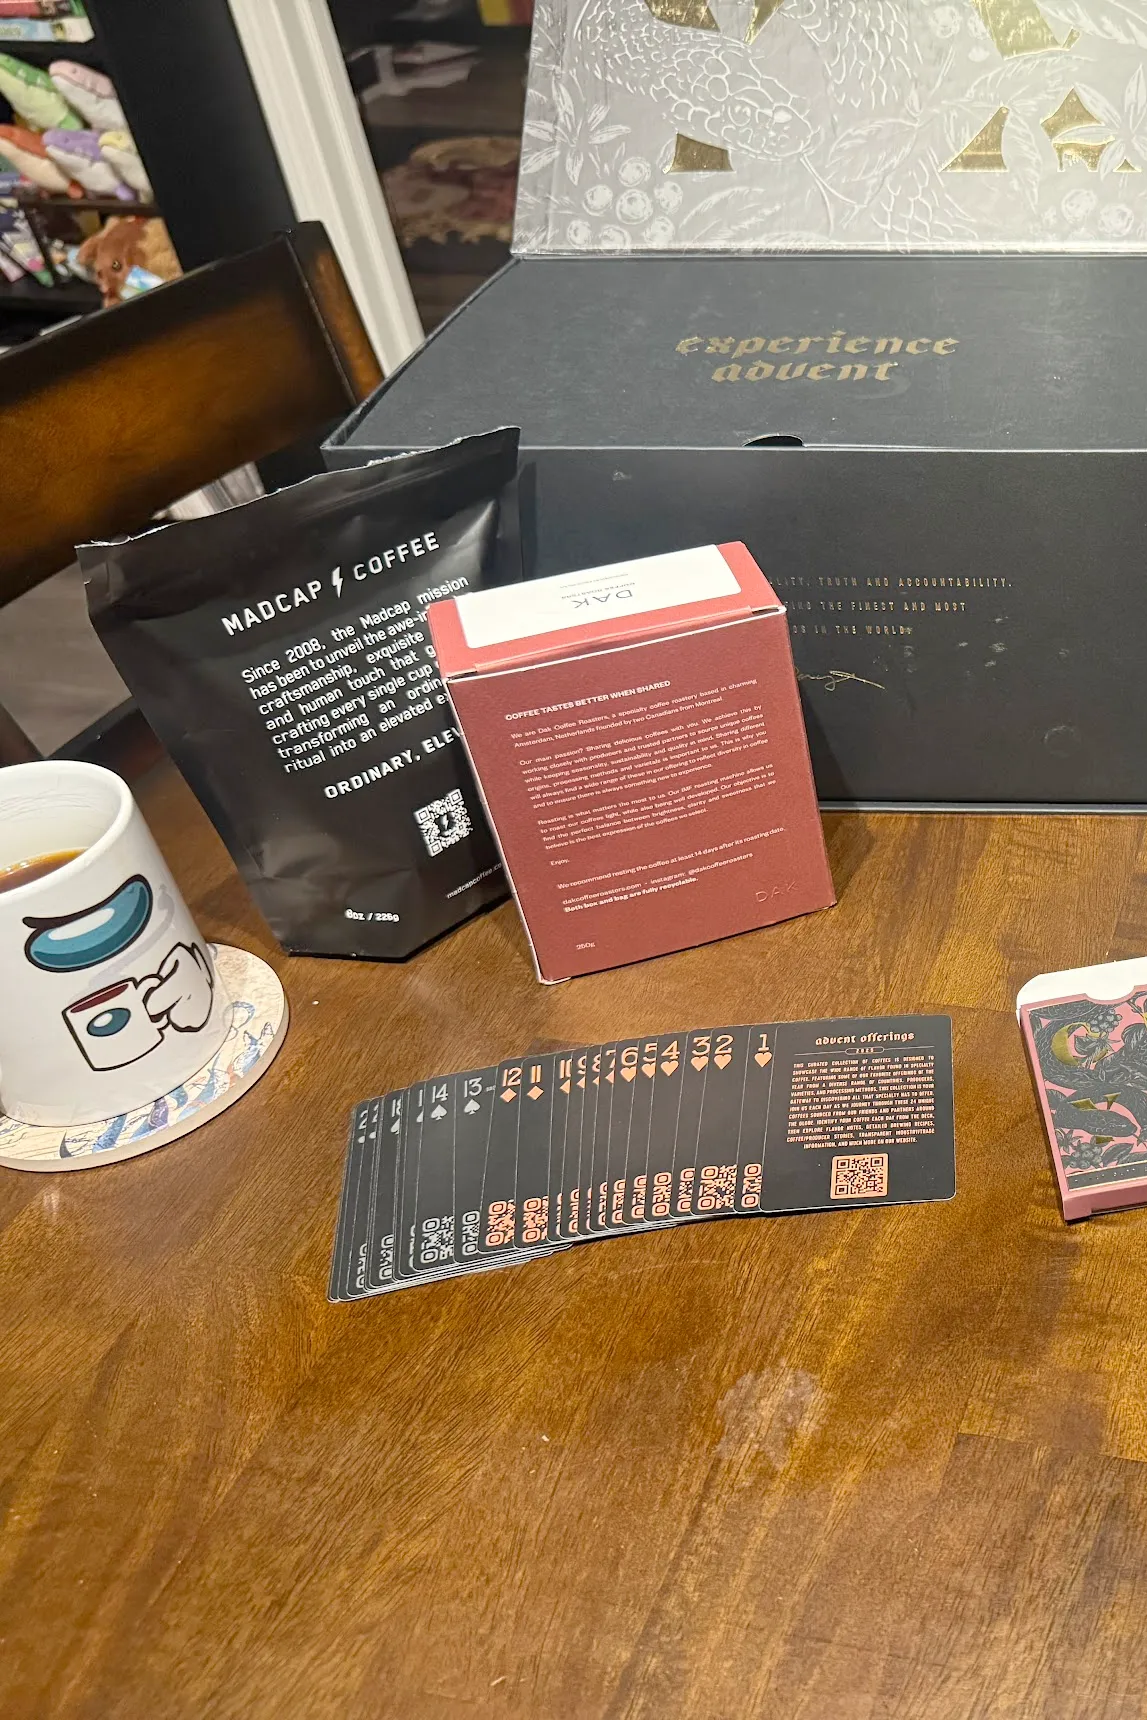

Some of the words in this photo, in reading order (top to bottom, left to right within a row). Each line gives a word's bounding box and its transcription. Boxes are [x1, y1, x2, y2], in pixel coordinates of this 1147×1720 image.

[676, 330, 960, 359] experience
[711, 359, 899, 383] advent
[221, 580, 323, 636] MADCAP
[353, 531, 440, 581] COFFEE
[769, 577, 811, 588] LITY,
[818, 577, 858, 587] TRUTH
[867, 577, 889, 587] AND
[899, 577, 1012, 587] ACCOUNTABILITY.
[571, 590, 632, 608] DAK
[820, 601, 842, 611] THE
[851, 601, 895, 611] FINEST
[903, 601, 926, 611] AND
[934, 602, 966, 612] MOST
[241, 659, 280, 683] Since
[285, 637, 325, 663] 2008,
[330, 625, 355, 641] the
[359, 600, 411, 629] Madcap
[416, 576, 468, 604] mission
[814, 625, 828, 635] IN
[835, 625, 857, 635] THE
[249, 681, 277, 699] has
[275, 665, 310, 687] been
[308, 658, 325, 670] to
[324, 637, 364, 663] unveil
[362, 629, 386, 645] the
[258, 664, 357, 714] craftsmanship,
[365, 631, 424, 663] exquisite
[265, 709, 294, 730] and
[297, 688, 343, 715] human
[346, 666, 385, 690] touch
[389, 649, 419, 670] that
[505, 708, 540, 720] COFFEE
[539, 701, 574, 713] TASTES
[574, 694, 609, 706] BETTER
[609, 688, 635, 698] WHEN
[636, 680, 670, 693] SHARED
[272, 713, 330, 749] crafting
[330, 694, 366, 719] every
[367, 676, 406, 700] single
[407, 664, 432, 681] cup
[553, 722, 576, 730] Coffee
[618, 706, 647, 716] specialty
[649, 701, 669, 709] coffee
[671, 693, 697, 703] roastery
[699, 687, 719, 696] based
[728, 678, 757, 689] charming
[277, 713, 369, 758] transforming
[378, 699, 396, 713] an
[406, 673, 444, 699] ordin
[284, 749, 326, 772] ritual
[328, 738, 356, 757] into
[359, 728, 377, 742] an
[378, 698, 433, 732] elevated
[514, 736, 554, 747] Amsterdam,
[554, 727, 595, 739] Netherlands
[595, 720, 622, 730] founded
[645, 708, 679, 719] Canadians
[324, 749, 420, 798] ORDINARY,
[569, 872, 611, 886] recommend
[611, 867, 636, 876] resting
[647, 859, 669, 868] coffee
[677, 853, 694, 861] least
[702, 846, 718, 854] days
[718, 841, 734, 849] after
[743, 831, 769, 842] roasting
[446, 862, 502, 899] madcapcoffee.co
[755, 880, 799, 903] DAK
[562, 883, 641, 905] dakcoffeeroasters.com
[564, 904, 583, 912] Both
[598, 896, 613, 904] and
[641, 886, 658, 894] fully
[658, 877, 698, 890] recyclable.
[345, 909, 366, 921] 8oz
[374, 913, 400, 923] 226g
[576, 941, 596, 951] 250g
[691, 1036, 711, 1056] 3
[714, 1034, 734, 1055] 2
[758, 1033, 770, 1052] 1
[815, 1035, 856, 1046] advent
[860, 1031, 915, 1043] offerings
[621, 1046, 639, 1066] 6
[642, 1042, 658, 1062] 5
[660, 1040, 680, 1060] 4
[502, 1067, 522, 1087] 12
[530, 1064, 542, 1084] 11
[431, 1083, 449, 1103] 14
[463, 1077, 482, 1098] 13
